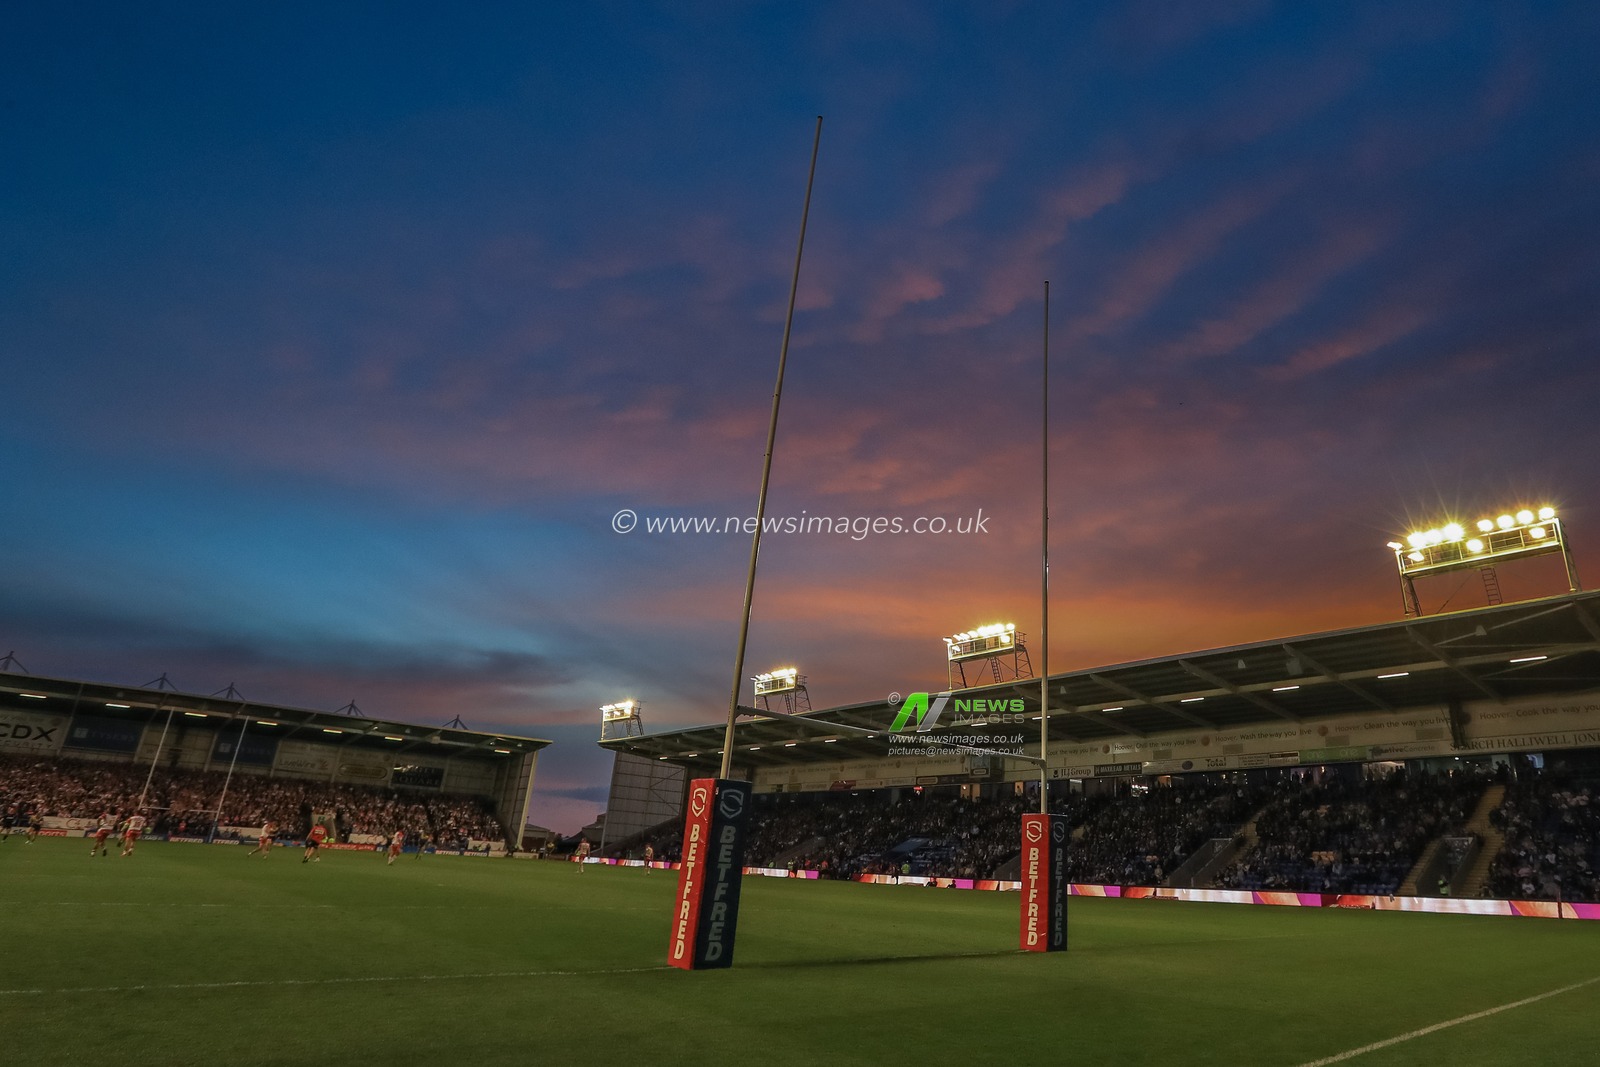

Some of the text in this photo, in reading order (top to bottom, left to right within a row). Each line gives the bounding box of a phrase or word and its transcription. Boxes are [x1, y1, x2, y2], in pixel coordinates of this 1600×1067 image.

[1542, 706, 1558, 715] the
[1561, 705, 1581, 714] way
[1386, 720, 1400, 728] the
[1401, 720, 1417, 728] way
[1419, 718, 1435, 728] you
[1284, 730, 1297, 738] you
[1299, 728, 1313, 736] live
[1497, 734, 1571, 748] HALLIWELL
[1205, 757, 1227, 767] Total
[1070, 767, 1092, 776] Group
[673, 824, 700, 960] BETFRED
[704, 825, 737, 962] BETFRED
[1027, 847, 1039, 946] BETFRED
[1053, 847, 1063, 947] BETFRED
